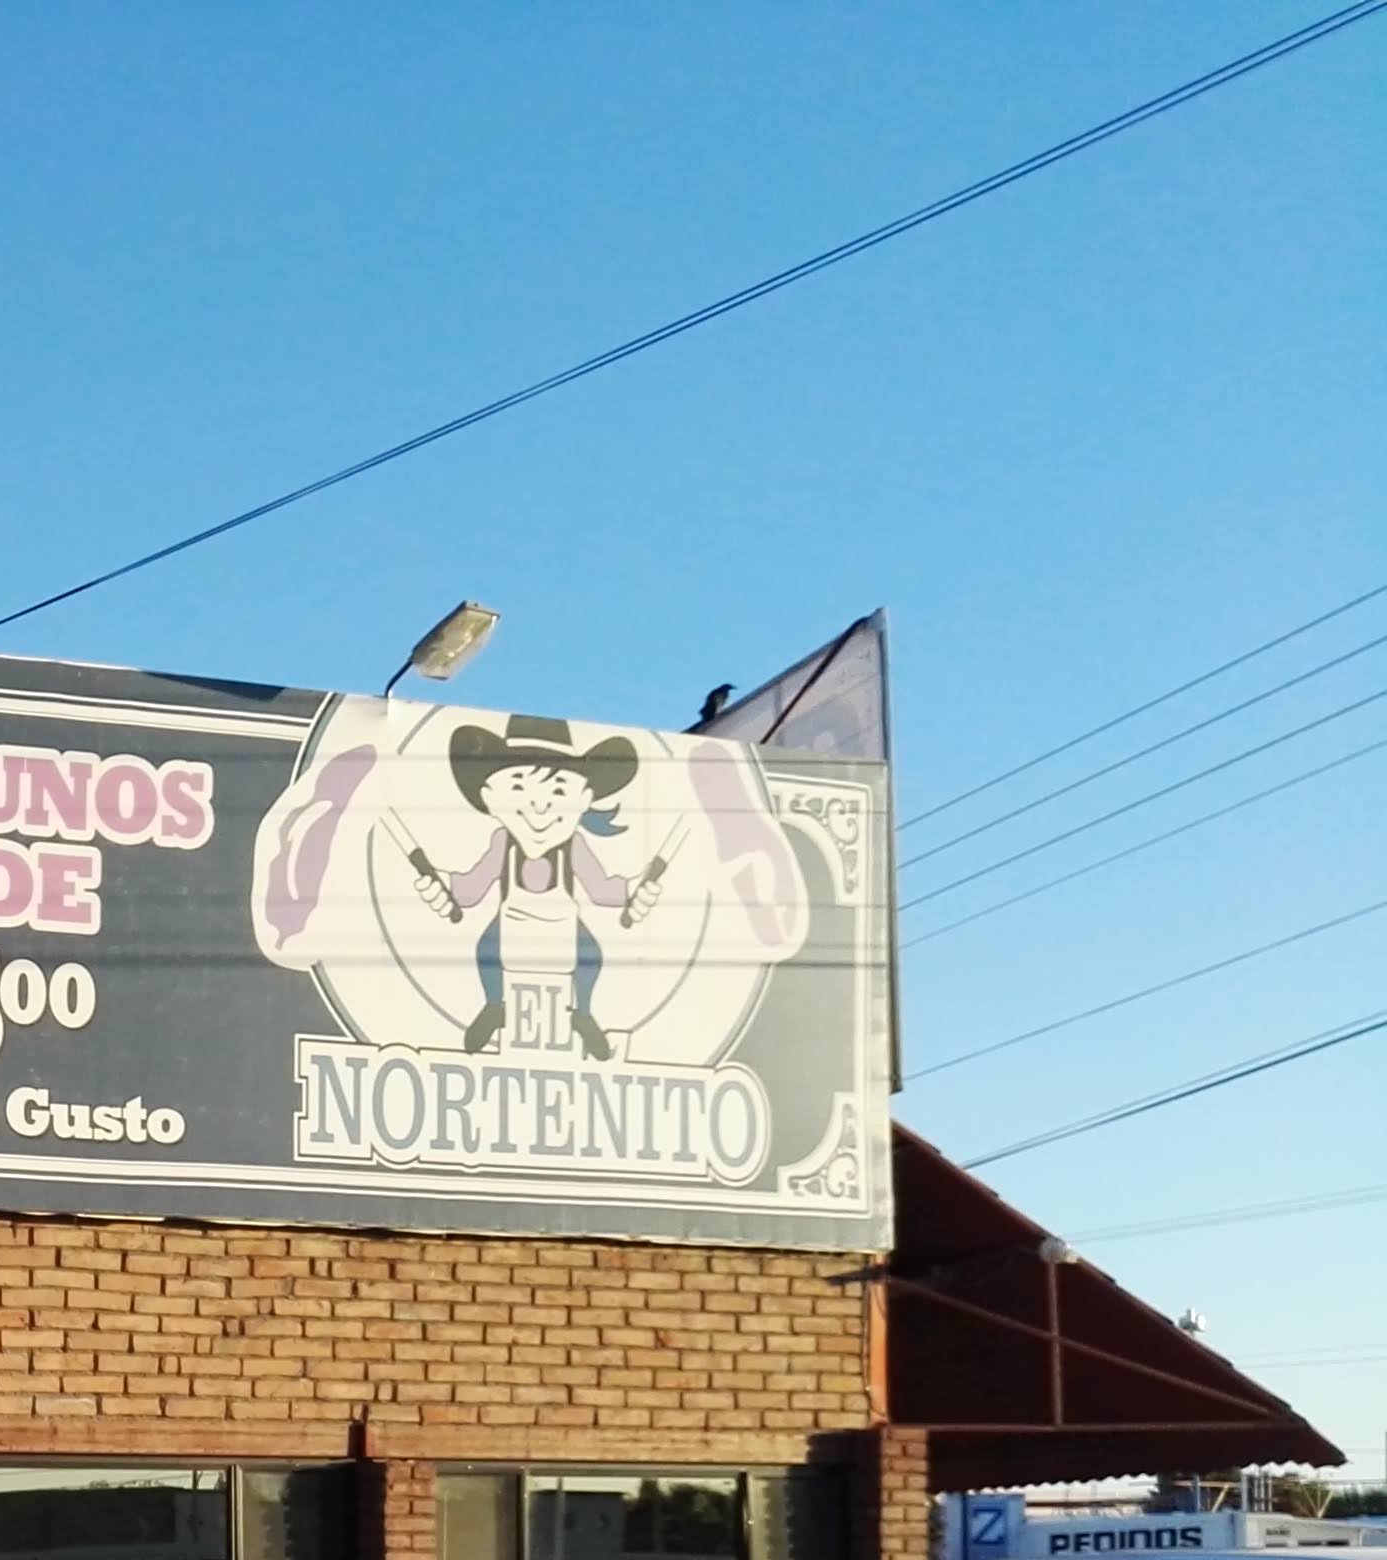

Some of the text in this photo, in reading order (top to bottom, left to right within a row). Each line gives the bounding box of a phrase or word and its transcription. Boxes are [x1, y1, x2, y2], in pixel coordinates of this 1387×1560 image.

[509, 982, 574, 1053] EL
[5, 1085, 186, 1145] Gusto
[308, 1053, 759, 1168] NORTENITO
